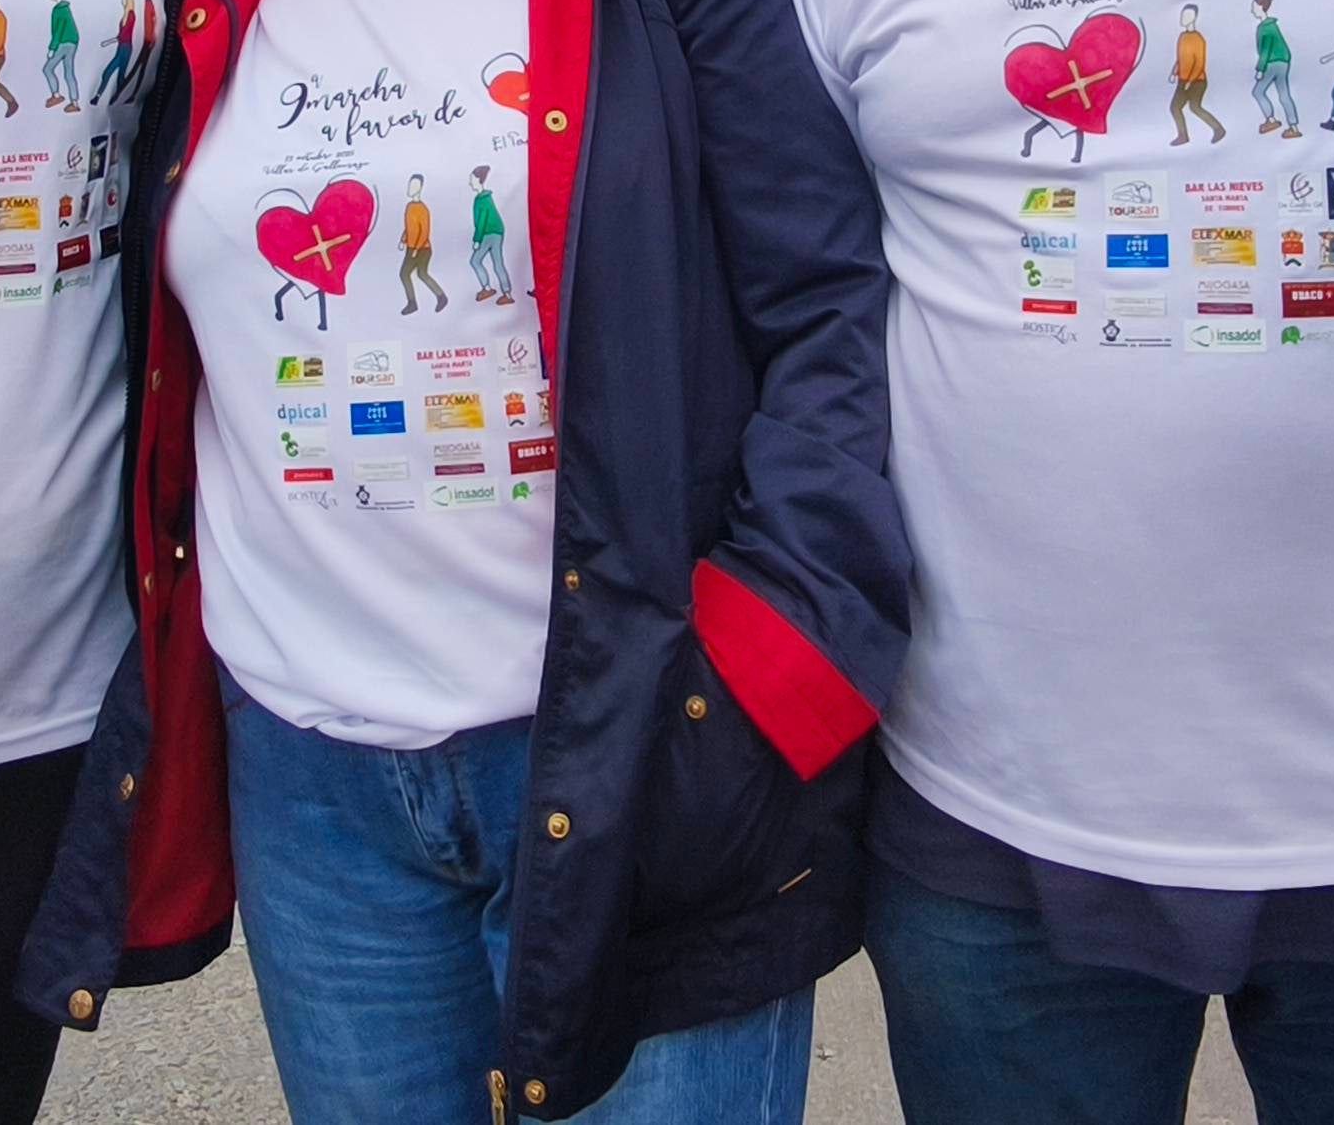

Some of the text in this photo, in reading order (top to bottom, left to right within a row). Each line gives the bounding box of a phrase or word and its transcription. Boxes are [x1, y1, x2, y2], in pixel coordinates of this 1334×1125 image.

[306, 67, 406, 111] marcha
[322, 89, 466, 145] a favor de
[2, 154, 16, 163] LAS
[19, 153, 49, 163] NIEVES
[1185, 181, 1264, 193] BAR LAS NIEVES
[1021, 231, 1077, 251] dpical
[1191, 228, 1253, 241] ELEXMAR
[1217, 329, 1261, 341] insadof
[417, 347, 486, 361] BAR LAS NIEVES
[277, 403, 327, 424] dpical
